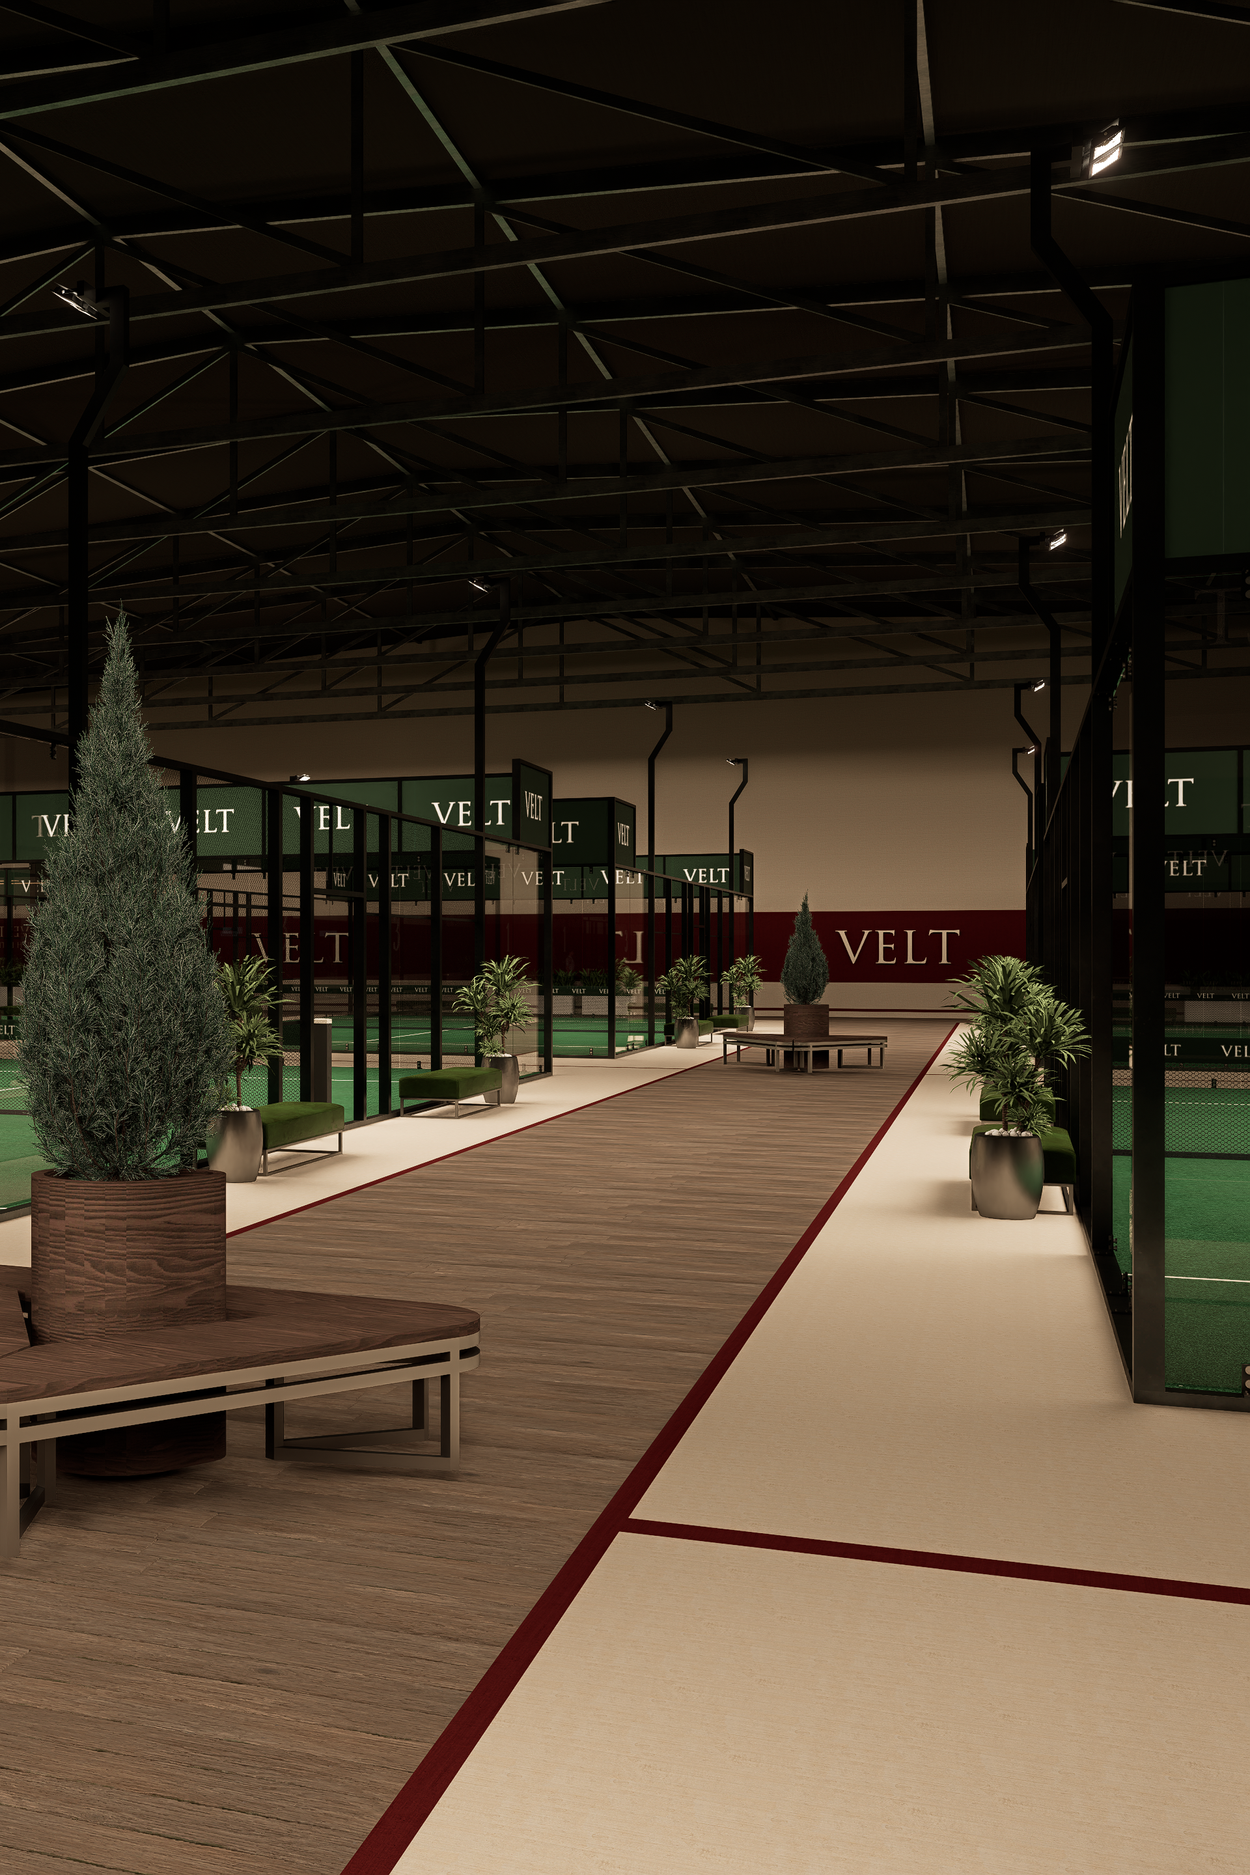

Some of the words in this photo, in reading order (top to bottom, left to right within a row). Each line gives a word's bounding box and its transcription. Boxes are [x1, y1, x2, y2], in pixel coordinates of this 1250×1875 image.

[431, 799, 511, 827] VET
[524, 790, 543, 822] VELT
[552, 821, 580, 844] LT
[617, 822, 630, 847] VELT
[682, 867, 730, 884] VELT
[1164, 859, 1207, 877] ELT
[333, 872, 347, 888] VELT
[367, 873, 409, 888] VLT
[443, 872, 476, 887] VEL
[521, 870, 565, 886] VET
[835, 929, 961, 965] VELT
[1163, 1043, 1182, 1057] LT
[1220, 1045, 1250, 1058] VEL
